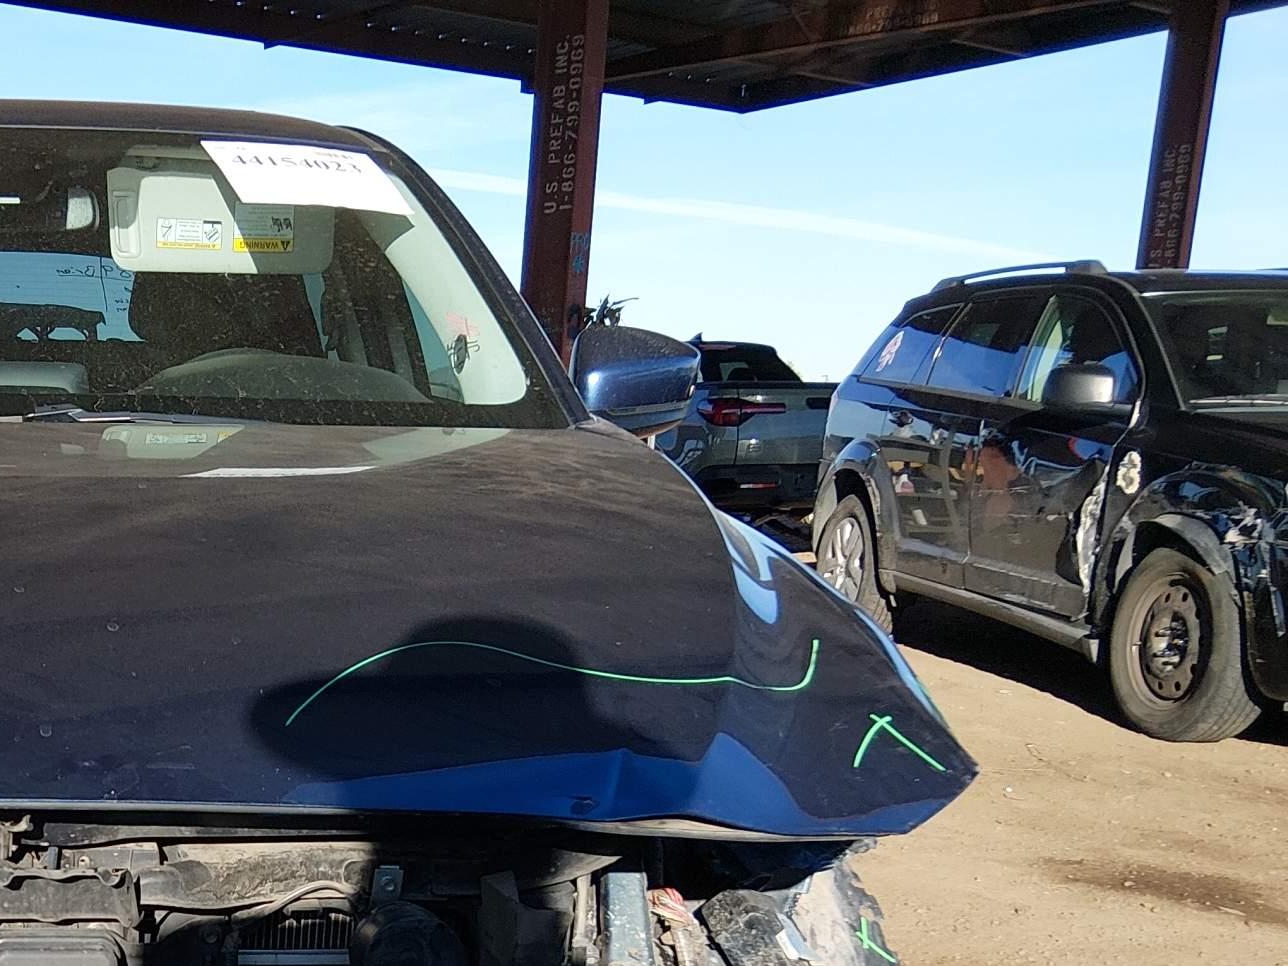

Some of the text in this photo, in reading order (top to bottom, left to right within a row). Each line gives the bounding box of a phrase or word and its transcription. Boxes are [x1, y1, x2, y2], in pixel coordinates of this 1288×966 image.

[544, 34, 570, 214] U.S. PREFAB INC.
[559, 34, 584, 210] 1-866-799-0969
[1164, 144, 1192, 265] -866-799-0969
